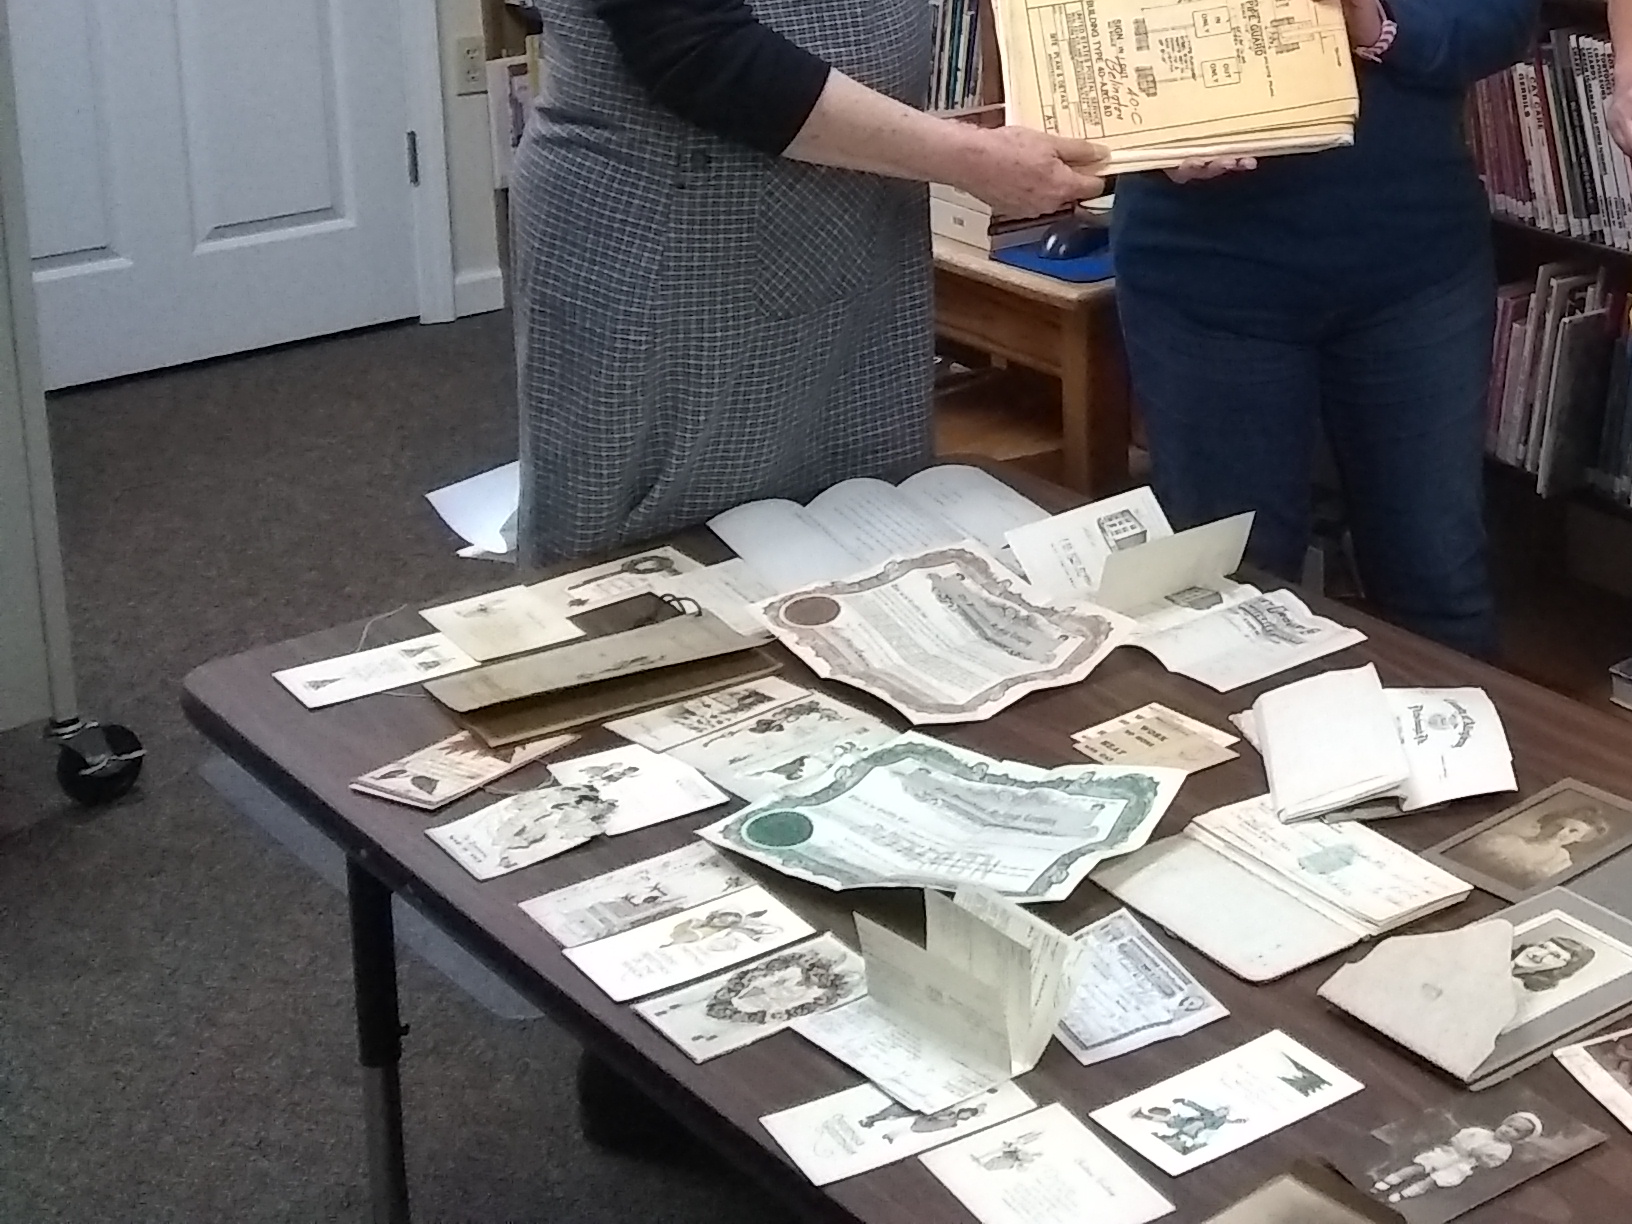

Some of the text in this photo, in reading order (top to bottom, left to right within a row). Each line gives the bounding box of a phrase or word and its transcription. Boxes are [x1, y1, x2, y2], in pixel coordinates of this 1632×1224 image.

[1085, 0, 1100, 38] BUILDING
[1200, 13, 1211, 34] ONLY
[1245, 0, 1258, 22] PIPE
[1112, 18, 1124, 41] SIGN
[1249, 23, 1264, 57] GUARD
[1052, 51, 1063, 72] PLAN
[1079, 35, 1090, 64] STATES
[1092, 41, 1104, 65] TYPE
[1208, 63, 1219, 84] ONLY
[1221, 63, 1232, 79] OUT
[1586, 47, 1597, 81] LIZARDS
[1084, 65, 1095, 94] POSTAL
[1104, 56, 1125, 122] Belington
[1530, 76, 1540, 101] CAT
[1057, 79, 1069, 110] DETAILS
[1518, 73, 1531, 118] GERBILS
[1044, 114, 1055, 131] A-1
